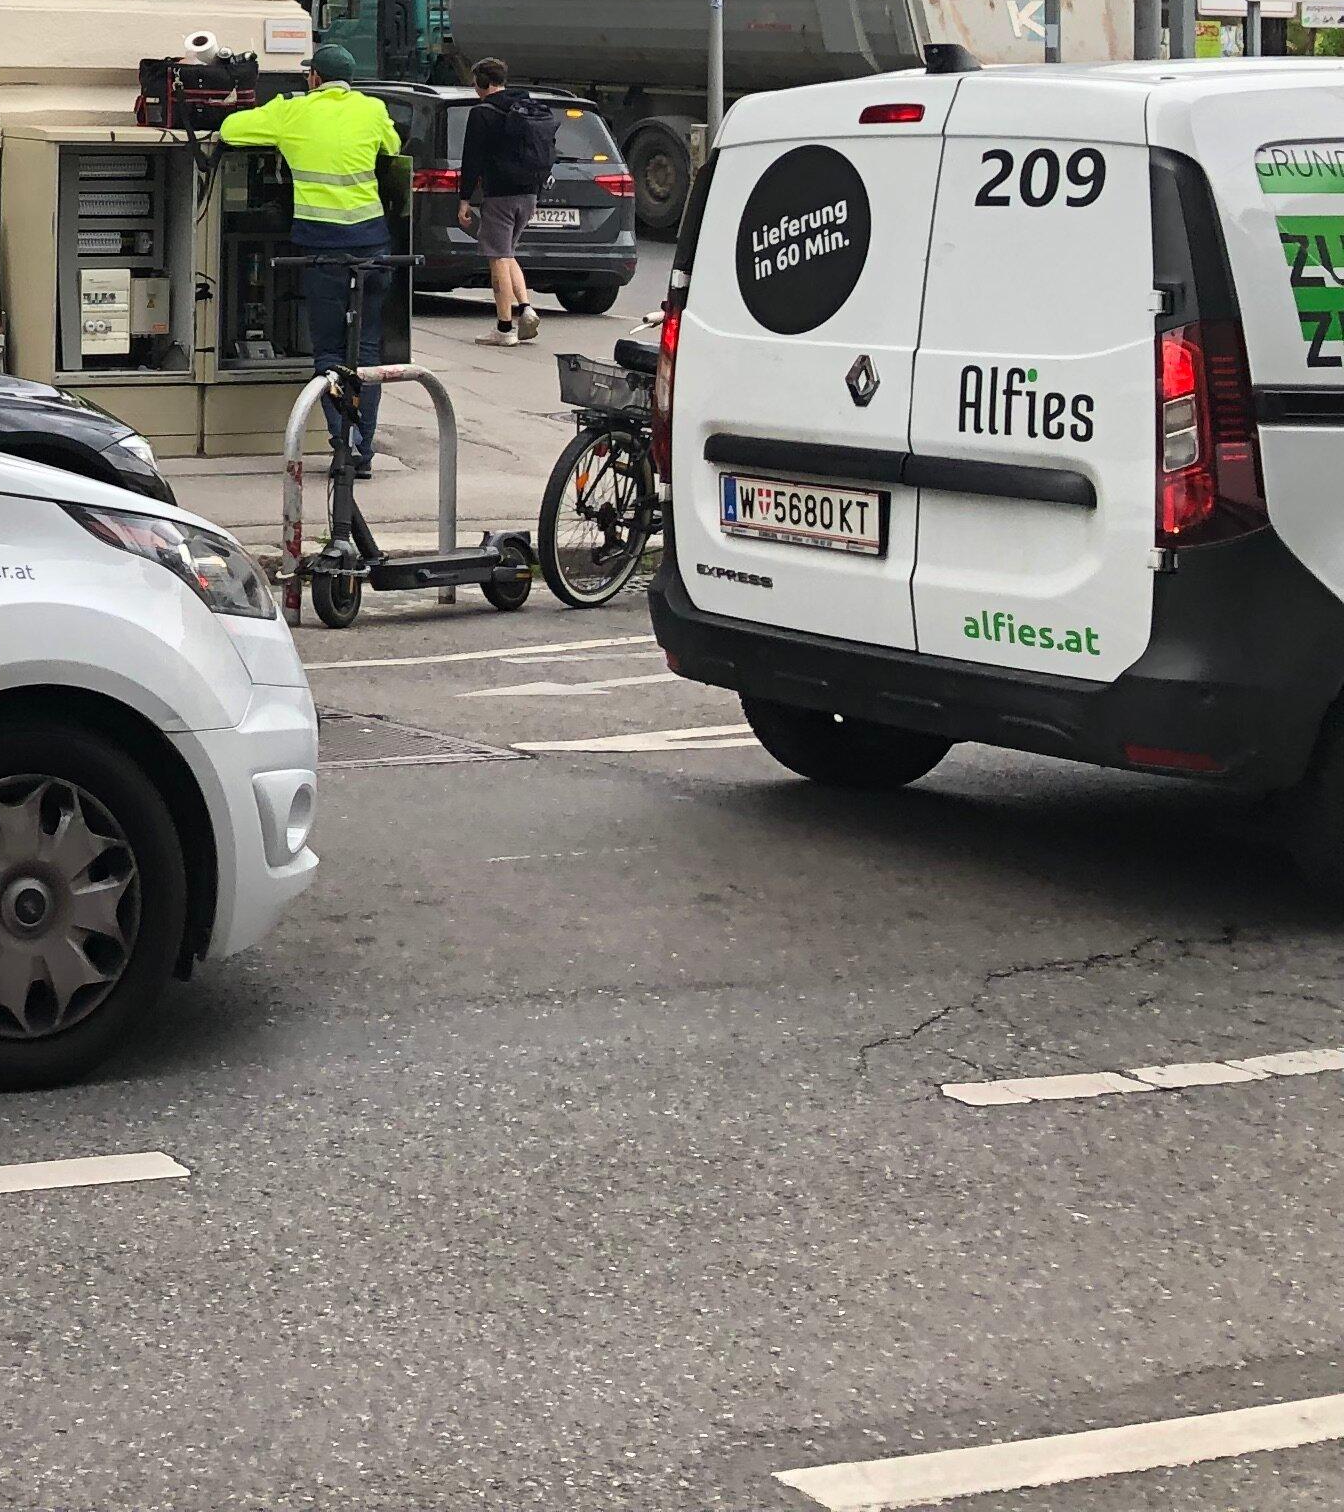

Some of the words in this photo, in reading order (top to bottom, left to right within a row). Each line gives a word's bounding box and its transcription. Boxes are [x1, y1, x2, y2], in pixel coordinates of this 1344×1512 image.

[974, 147, 1107, 208] 209
[752, 199, 848, 253] Lieferung
[754, 256, 773, 281] in
[776, 243, 801, 271] 60
[805, 229, 850, 261] Min.
[958, 364, 1095, 443] Alfies
[696, 563, 774, 588] EXPRESS
[963, 610, 1101, 656] alfies.at
